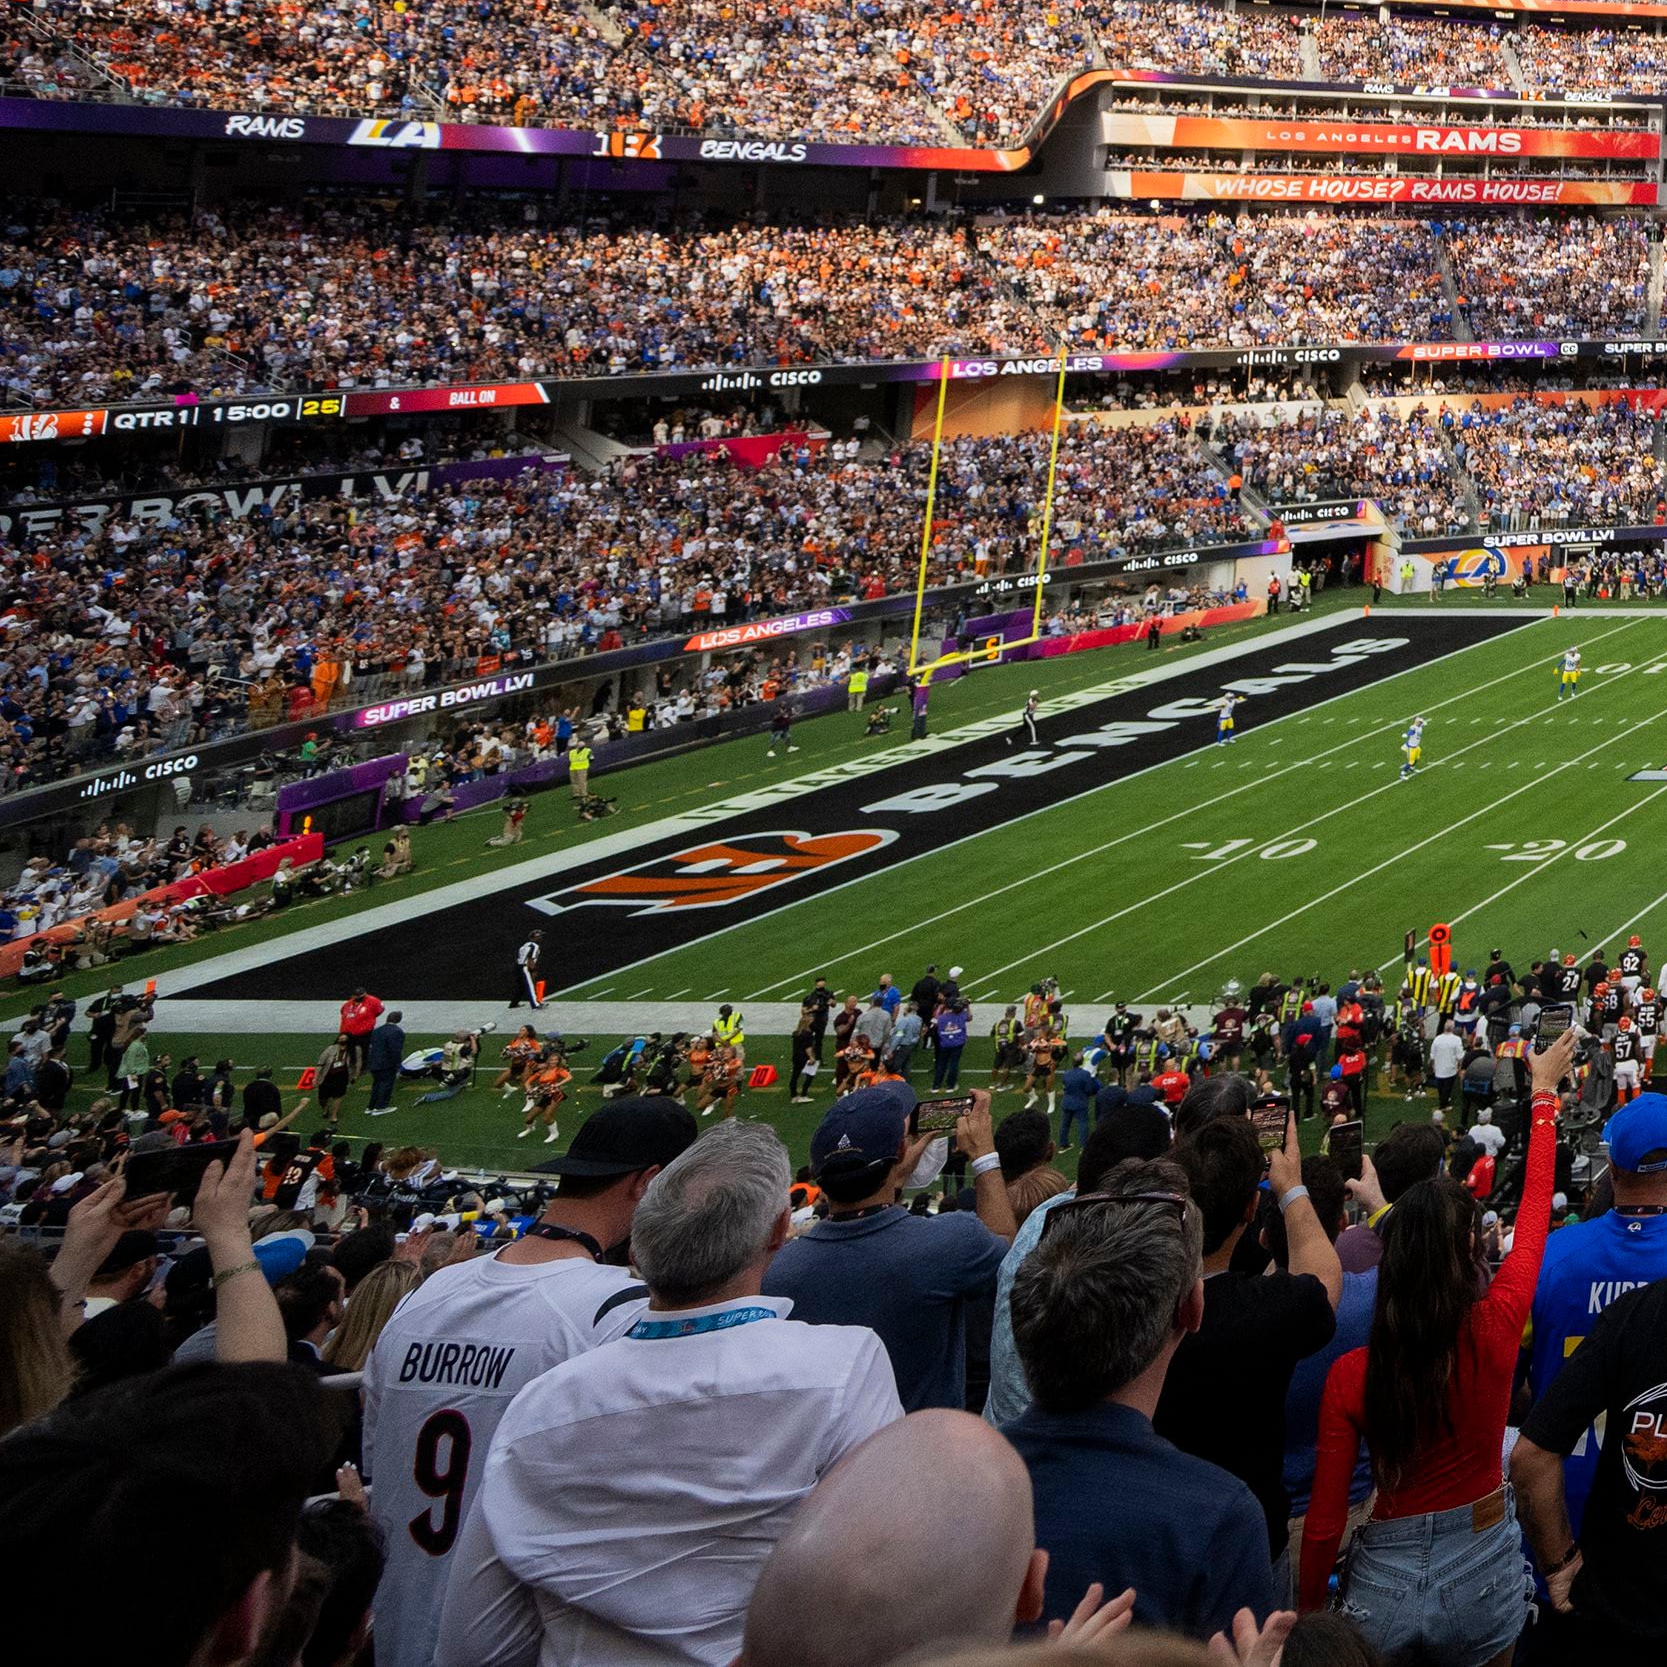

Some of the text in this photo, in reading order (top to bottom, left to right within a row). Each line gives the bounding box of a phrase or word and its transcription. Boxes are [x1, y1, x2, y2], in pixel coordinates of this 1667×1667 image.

[223, 112, 306, 142] RAMS
[1266, 128, 1523, 153] LOS ANGELES RAMS
[698, 138, 808, 165] BENGALS
[1214, 178, 1564, 204] WHOSE HOUSE? RAMS HOUSE!
[1294, 349, 1341, 363] CISCO
[1412, 342, 1547, 359] SUPER BOWL
[769, 368, 823, 387] CISCO
[212, 402, 290, 422] 15:00
[303, 399, 340, 416] 25
[449, 391, 475, 405] BALL
[478, 390, 496, 404] ON
[1483, 529, 1616, 548] SUPER BOWL LVI
[698, 611, 835, 650] LOS ANGELES
[362, 673, 536, 725] SUPER BOWL LVI
[859, 635, 1411, 816] BENGALS
[143, 754, 199, 781] CISCO
[1188, 836, 1321, 863] 10
[1498, 837, 1629, 863] 20
[1623, 955, 1640, 971] 92
[398, 1340, 516, 1390] BURROW
[408, 1408, 473, 1556] 9
